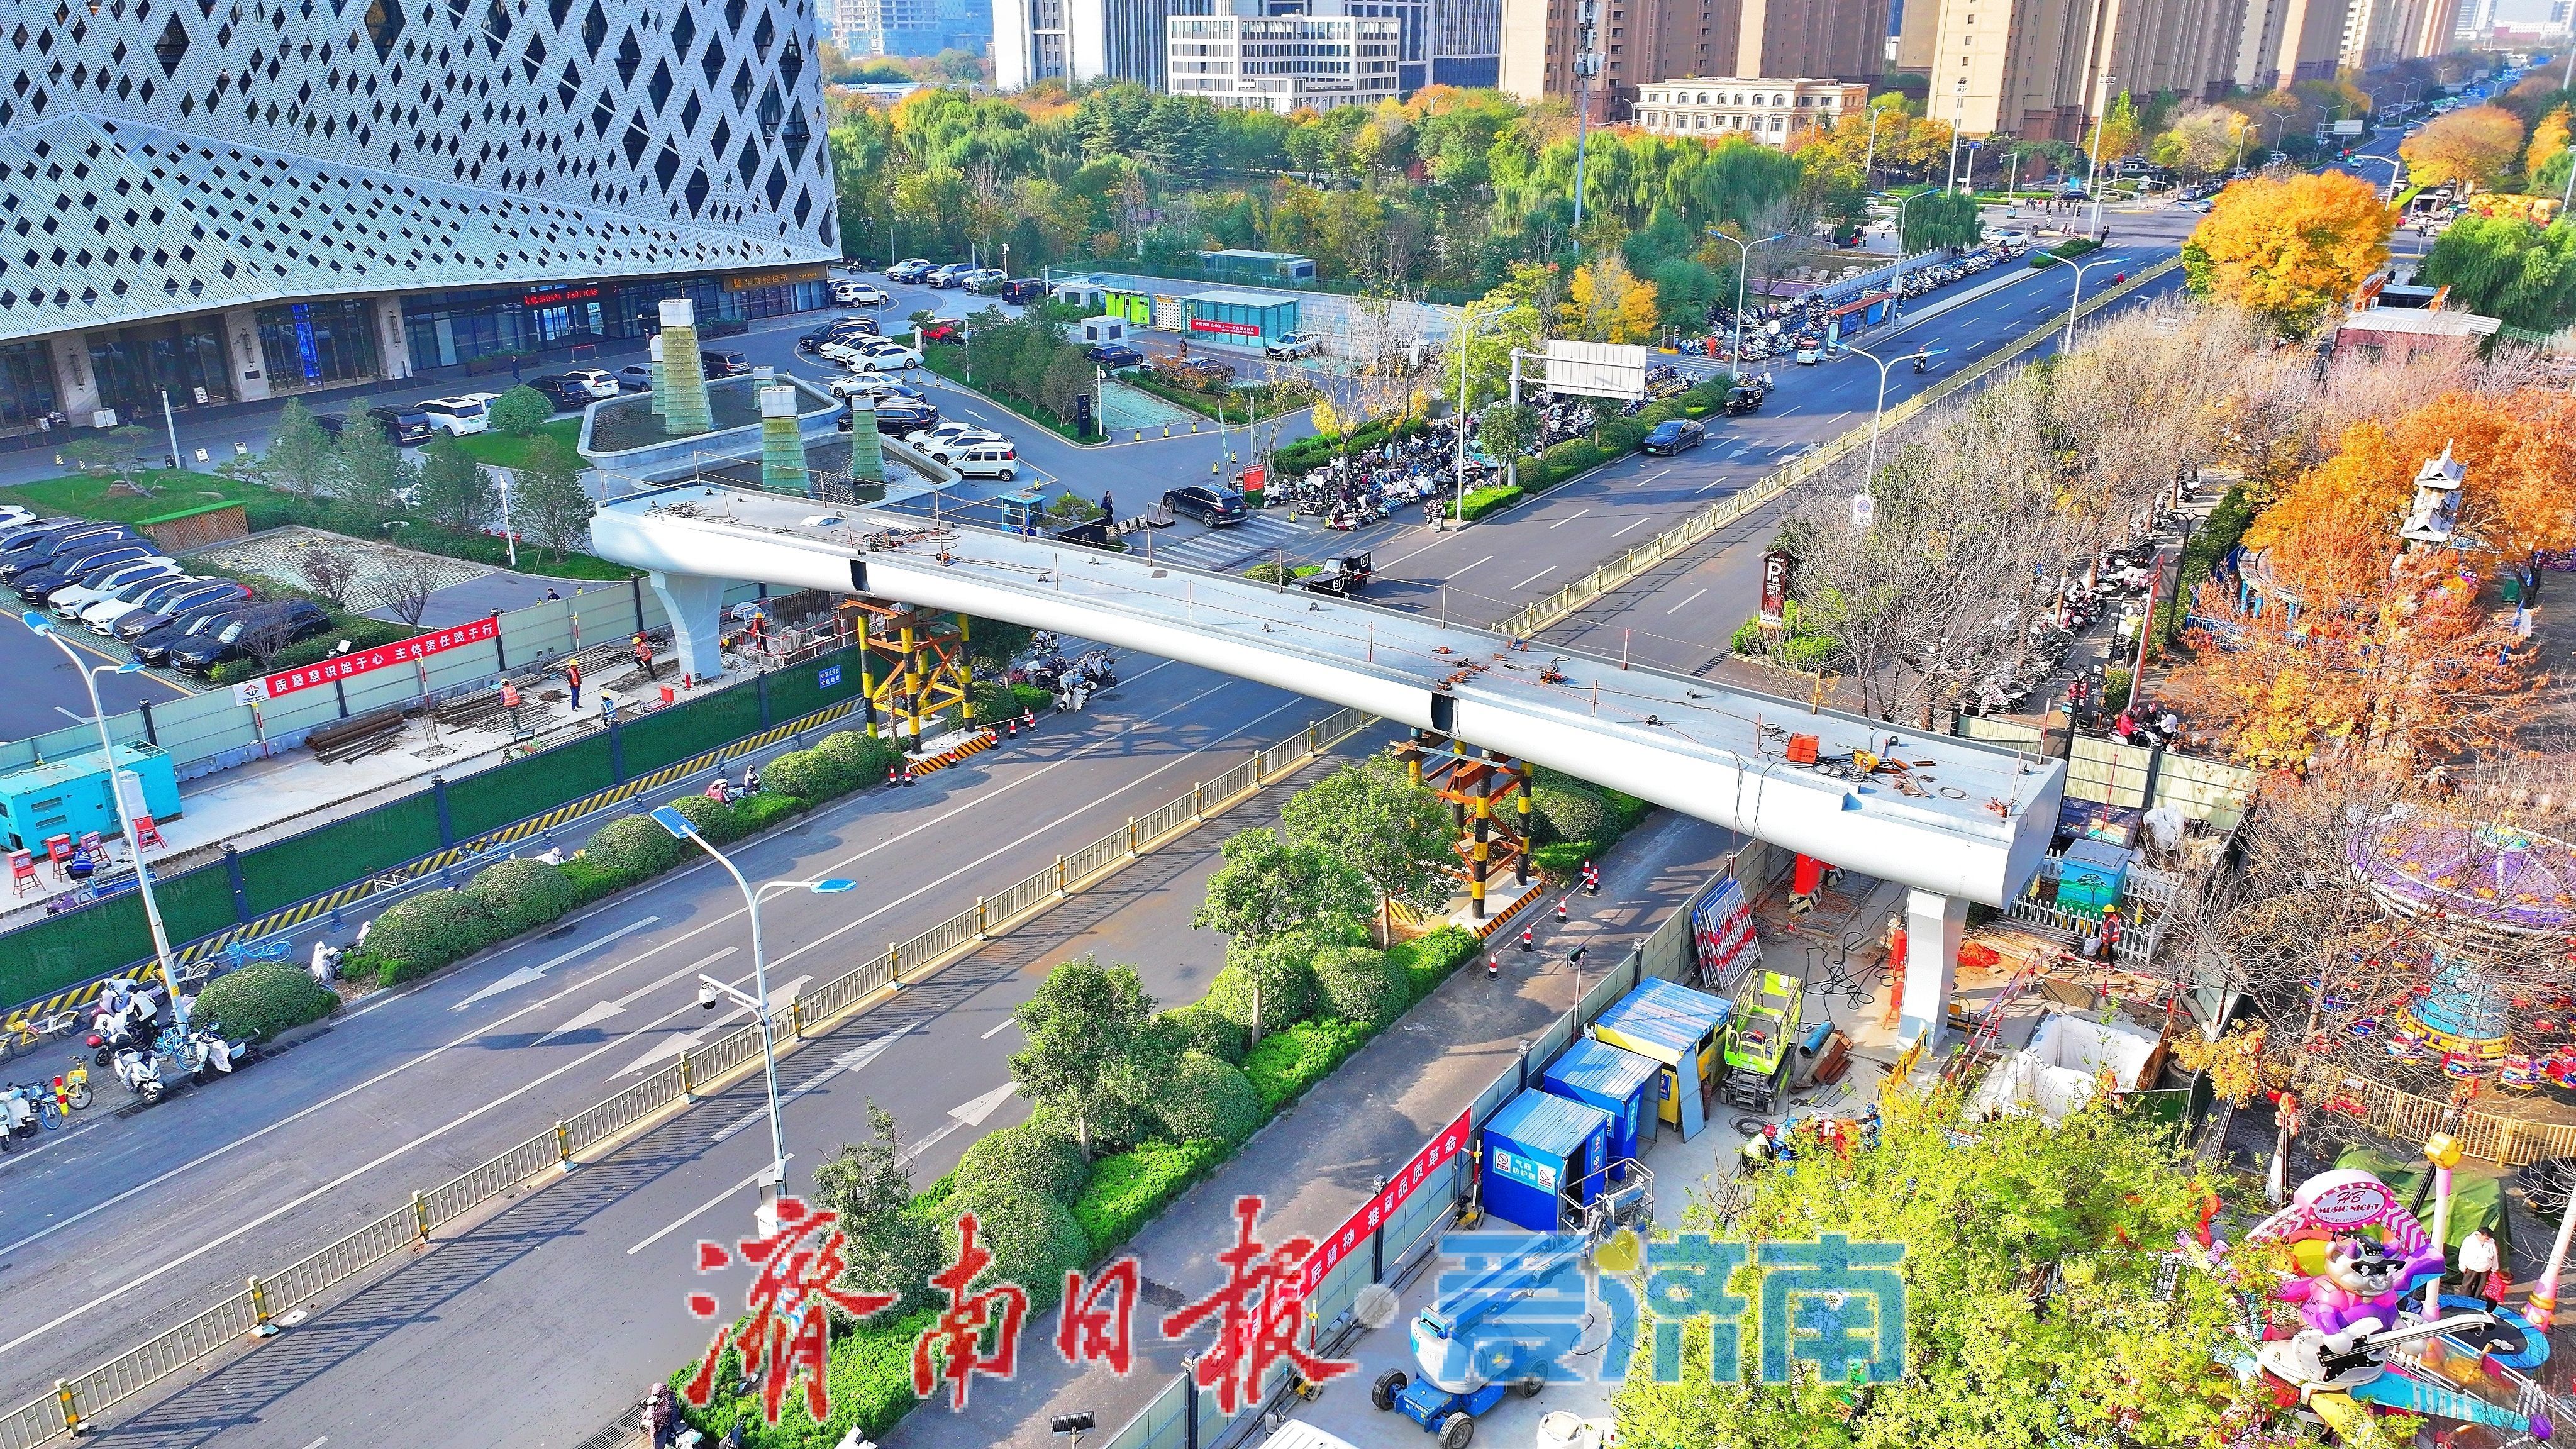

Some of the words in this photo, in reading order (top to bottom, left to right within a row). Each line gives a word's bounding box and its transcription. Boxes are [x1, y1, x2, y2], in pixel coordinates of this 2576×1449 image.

[275, 653, 384, 693] 质量意识始于心
[394, 623, 494, 660] 主体责任践于行
[1367, 1135, 1457, 1231] 推动品质革命
[2318, 1204, 2348, 1214] MUSIC
[2350, 1203, 2380, 1211] NIGHT
